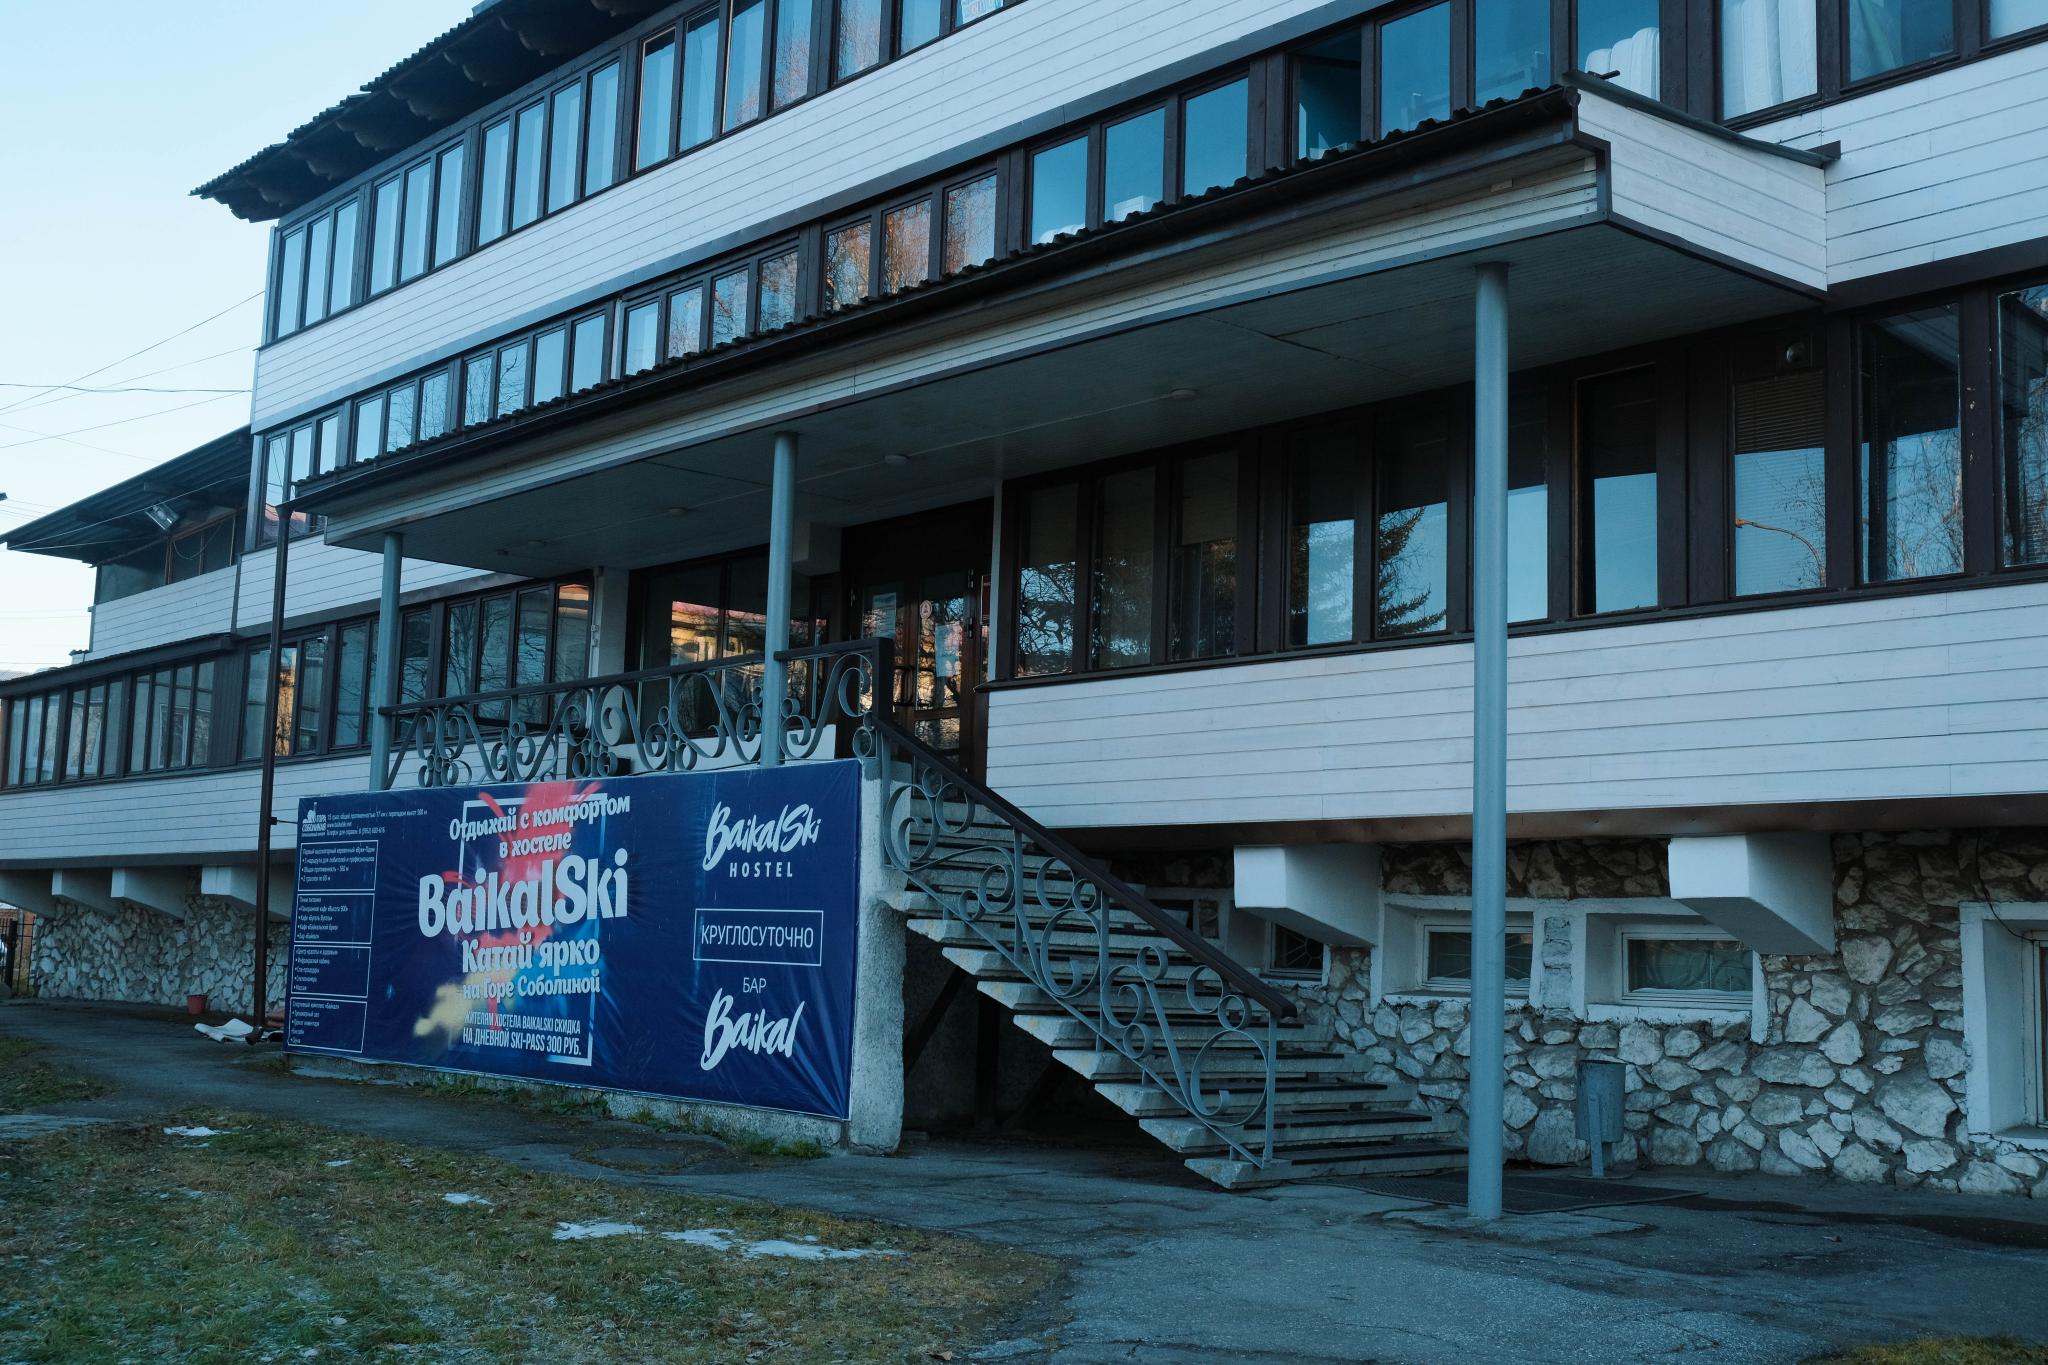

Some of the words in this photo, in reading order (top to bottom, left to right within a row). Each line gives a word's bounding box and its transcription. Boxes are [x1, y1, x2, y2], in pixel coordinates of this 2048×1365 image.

[449, 806, 517, 841] Отдыхай
[520, 812, 529, 829] с
[532, 795, 631, 828] комфортом
[500, 840, 508, 858] в
[512, 831, 572, 857] хостеле
[702, 801, 821, 871] BaikalSki
[729, 861, 793, 878] HOSTEL
[418, 848, 628, 937] BaikalSki
[701, 924, 814, 949] КРУГЛОСУТОЧНО
[462, 931, 533, 973] Катай
[538, 938, 600, 976] ярко
[463, 984, 480, 999] на
[482, 976, 514, 1003] Горе
[517, 968, 600, 997] Соболиной
[742, 977, 767, 994] БАР
[464, 1011, 494, 1026] ЖИТЕЛЯМ
[494, 1014, 522, 1029] ХОСТЕЛА
[522, 1016, 554, 1032] BAIKALSKI
[554, 1018, 581, 1035] СКИДКА
[700, 987, 806, 1071] Baikal
[462, 1027, 473, 1044] НА
[473, 1028, 510, 1047] ДНЕВНОЙ
[510, 1031, 545, 1052] SKI-PASS
[546, 1036, 562, 1054] 300
[563, 1037, 582, 1056] РУБ.
